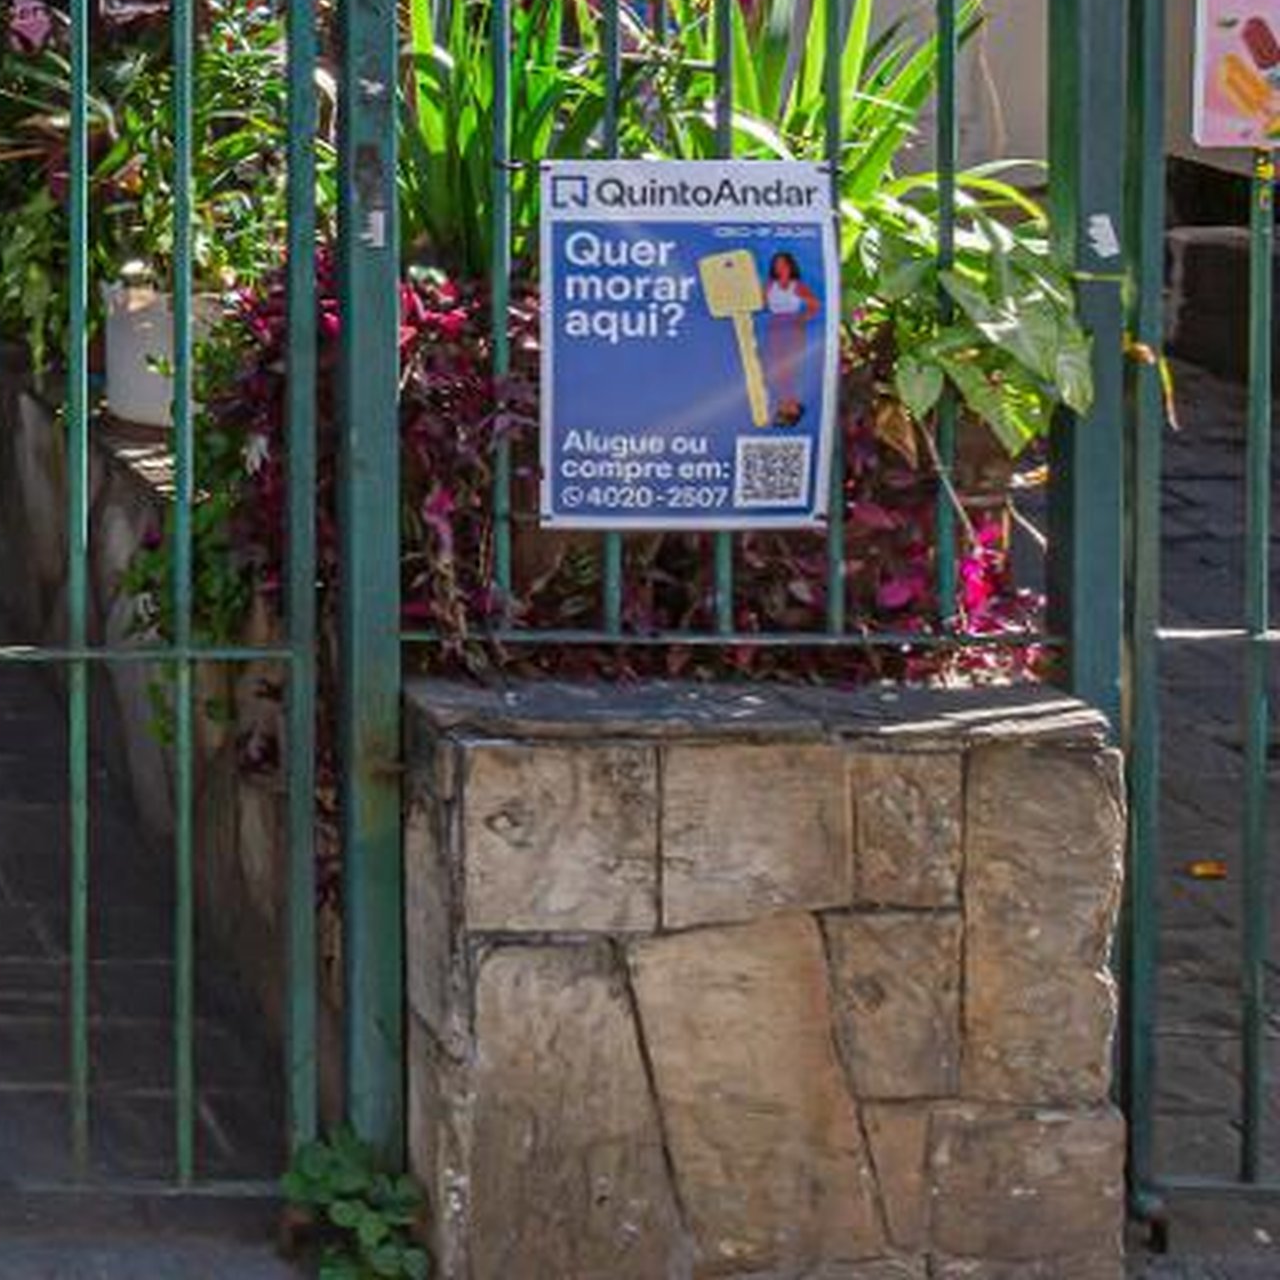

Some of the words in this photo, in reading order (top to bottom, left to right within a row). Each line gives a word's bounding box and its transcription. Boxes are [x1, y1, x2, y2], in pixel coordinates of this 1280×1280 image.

[595, 177, 818, 209] QuintoAndar
[564, 230, 677, 268] Quer
[564, 273, 695, 303] morar
[564, 303, 685, 345] aqui?
[561, 429, 665, 458] Alugue
[671, 435, 707, 455] ou
[561, 458, 674, 483] compre
[678, 461, 731, 479] em:
